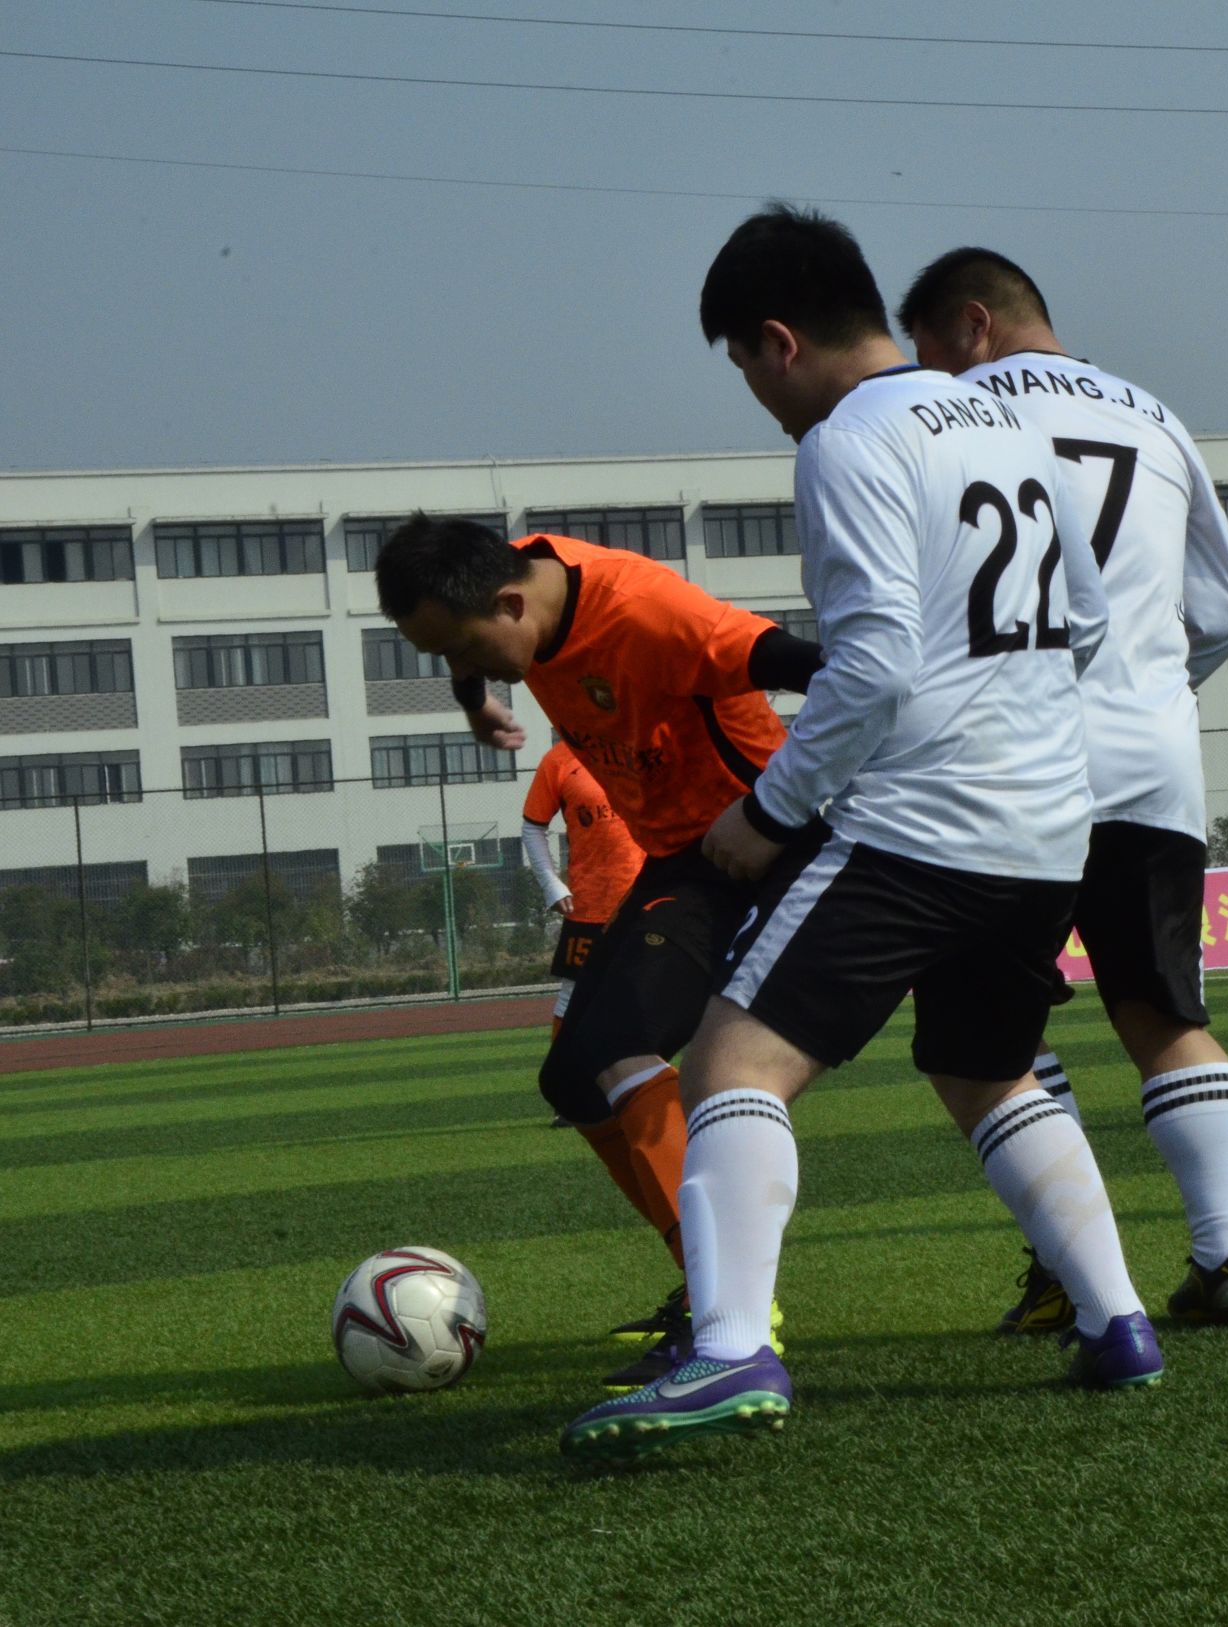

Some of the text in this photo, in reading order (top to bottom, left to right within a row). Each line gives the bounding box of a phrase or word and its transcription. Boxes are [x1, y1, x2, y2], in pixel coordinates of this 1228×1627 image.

[910, 397, 1022, 436] DANG.W
[976, 368, 1165, 424] WANG.J.J
[1052, 437, 1138, 575] 7
[959, 477, 1071, 658] 22
[564, 937, 593, 968] 15
